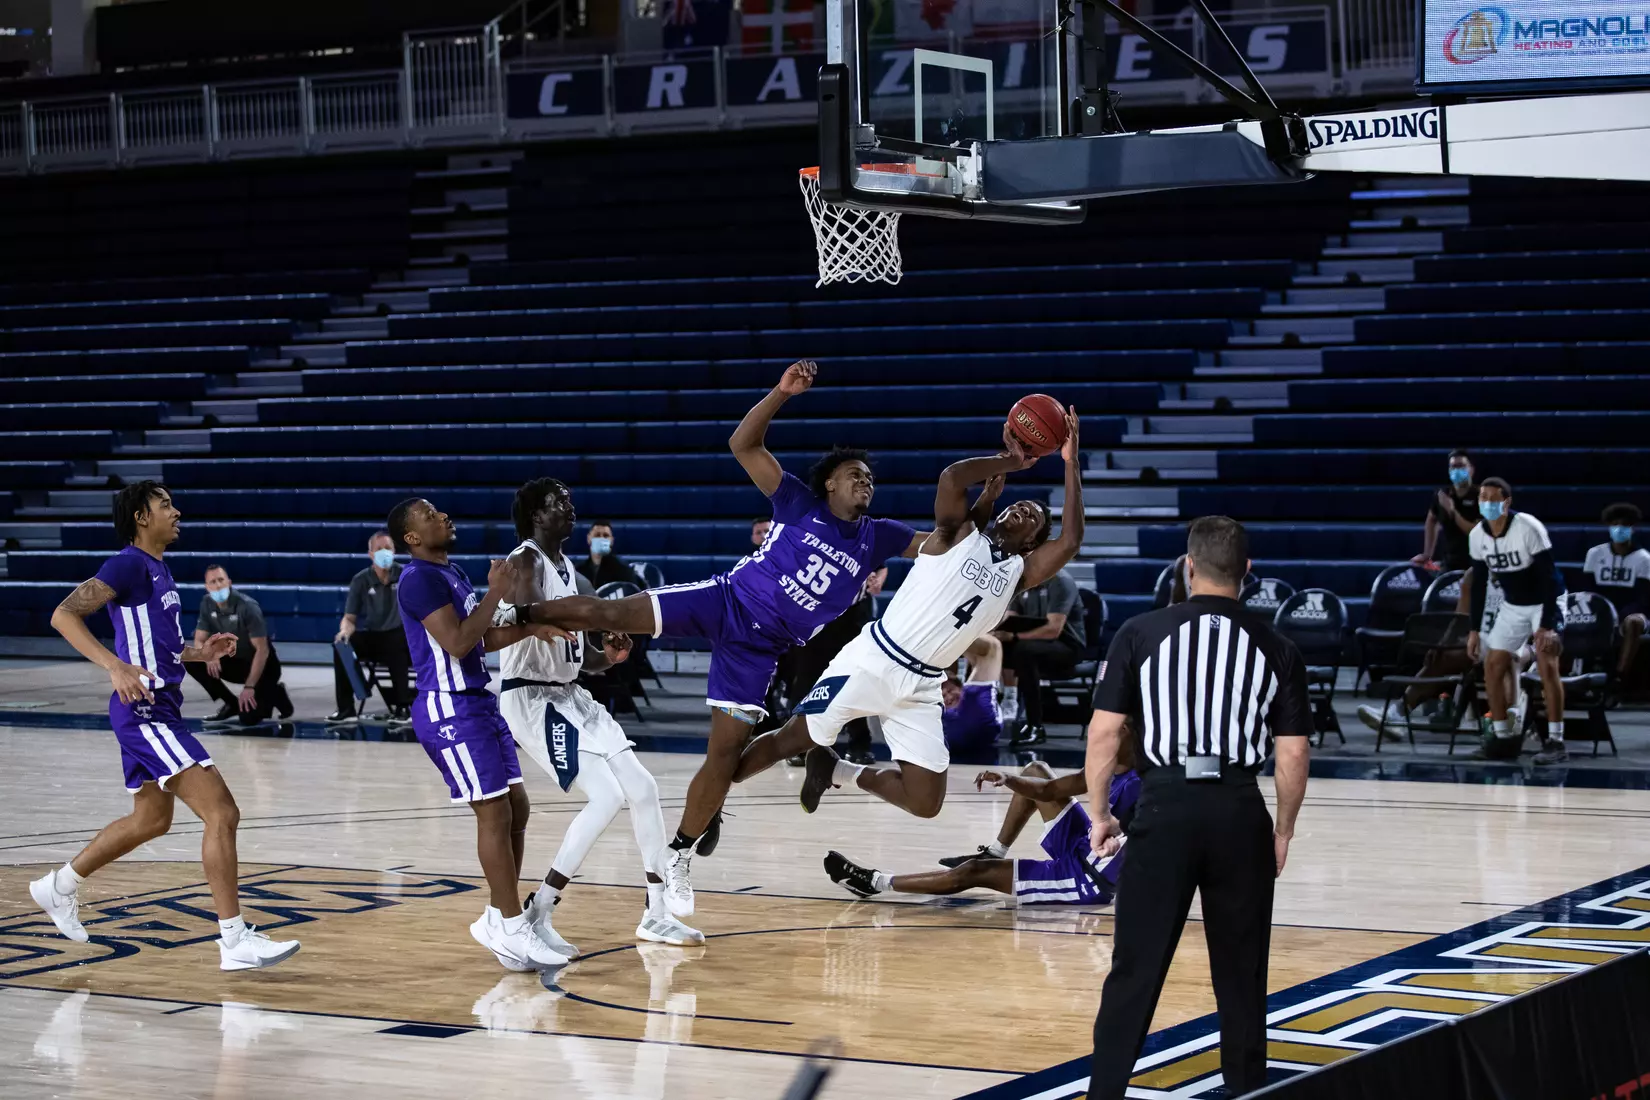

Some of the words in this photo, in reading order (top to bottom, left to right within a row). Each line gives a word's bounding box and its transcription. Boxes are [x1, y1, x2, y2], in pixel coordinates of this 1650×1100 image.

[1514, 40, 1573, 51] HEATING
[1578, 39, 1606, 48] AND
[1308, 108, 1438, 149] SPALDING
[1016, 409, 1048, 442] Wilson
[801, 531, 863, 577] TARLETON
[1486, 550, 1521, 569] CBU
[796, 553, 840, 595] 35
[960, 558, 1009, 597] CBU
[1600, 567, 1632, 583] CBU
[778, 574, 822, 612] STATE
[951, 594, 984, 631] 4
[1291, 608, 1329, 619] adidas
[552, 722, 569, 770] LANCERS
